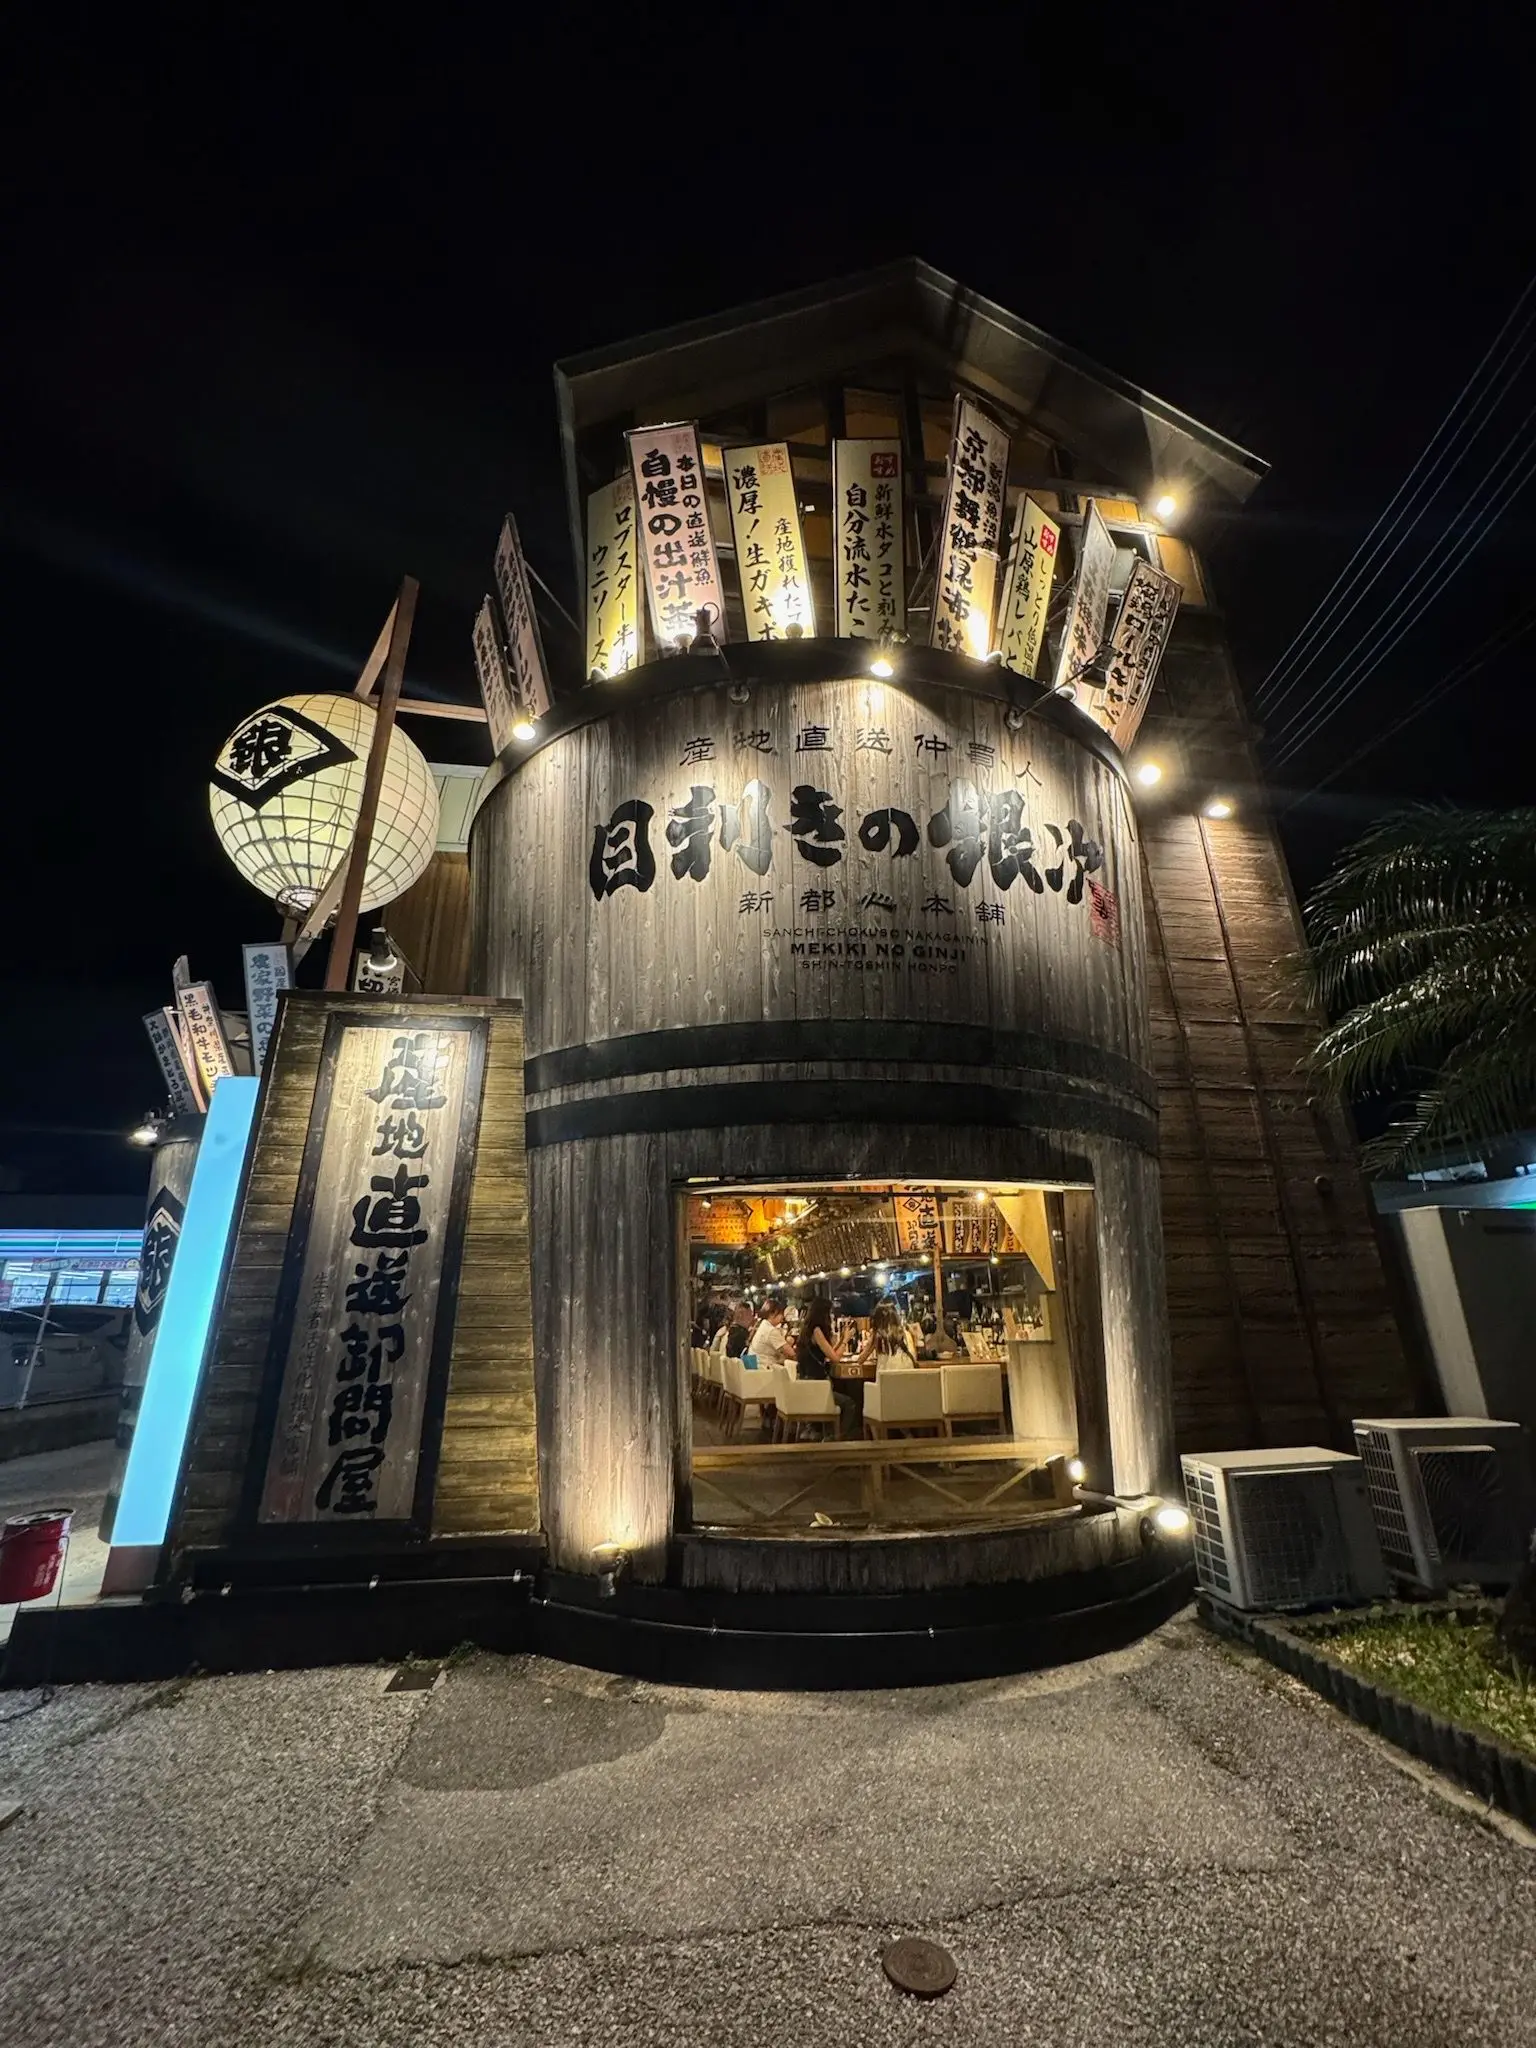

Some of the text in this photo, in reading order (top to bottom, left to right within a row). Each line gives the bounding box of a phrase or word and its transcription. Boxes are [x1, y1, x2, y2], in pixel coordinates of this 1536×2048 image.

[591, 544, 609, 670] ウニソース
[678, 725, 1045, 787] 産地直送仲買人
[589, 777, 1104, 905] 目利きの銀次
[738, 888, 1007, 926] 新都心本舗
[790, 943, 967, 962] MEKIKI NO GINJI
[801, 959, 957, 974] SHIN-TOSHIN HONPO
[315, 1032, 450, 1514] 産地直送卸問屋
